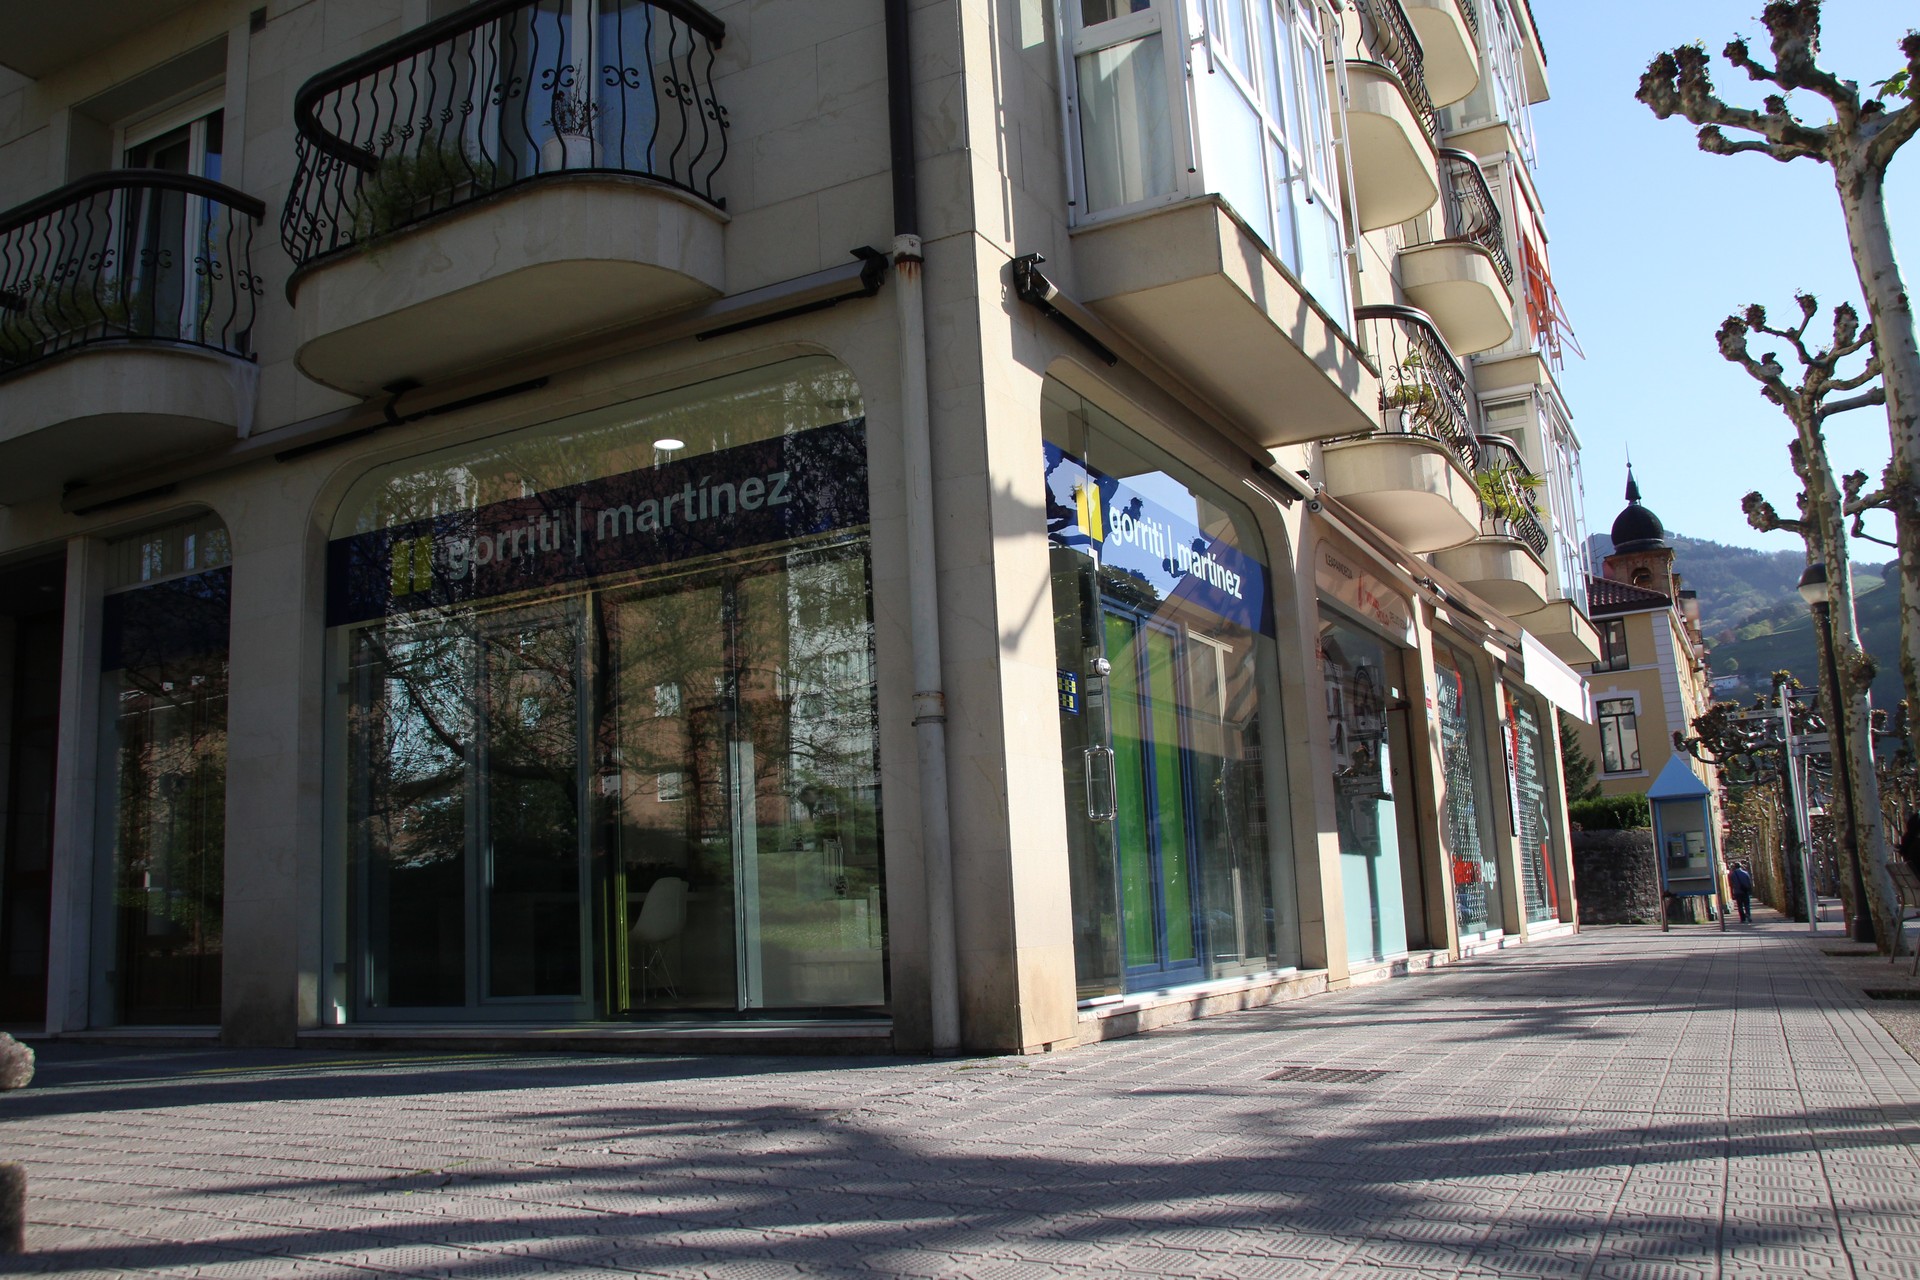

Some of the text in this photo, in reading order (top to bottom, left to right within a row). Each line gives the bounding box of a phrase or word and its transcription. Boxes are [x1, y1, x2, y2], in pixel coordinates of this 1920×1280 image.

[446, 470, 792, 580] gorriti martínez
[1109, 506, 1242, 600] gorriti martínez
